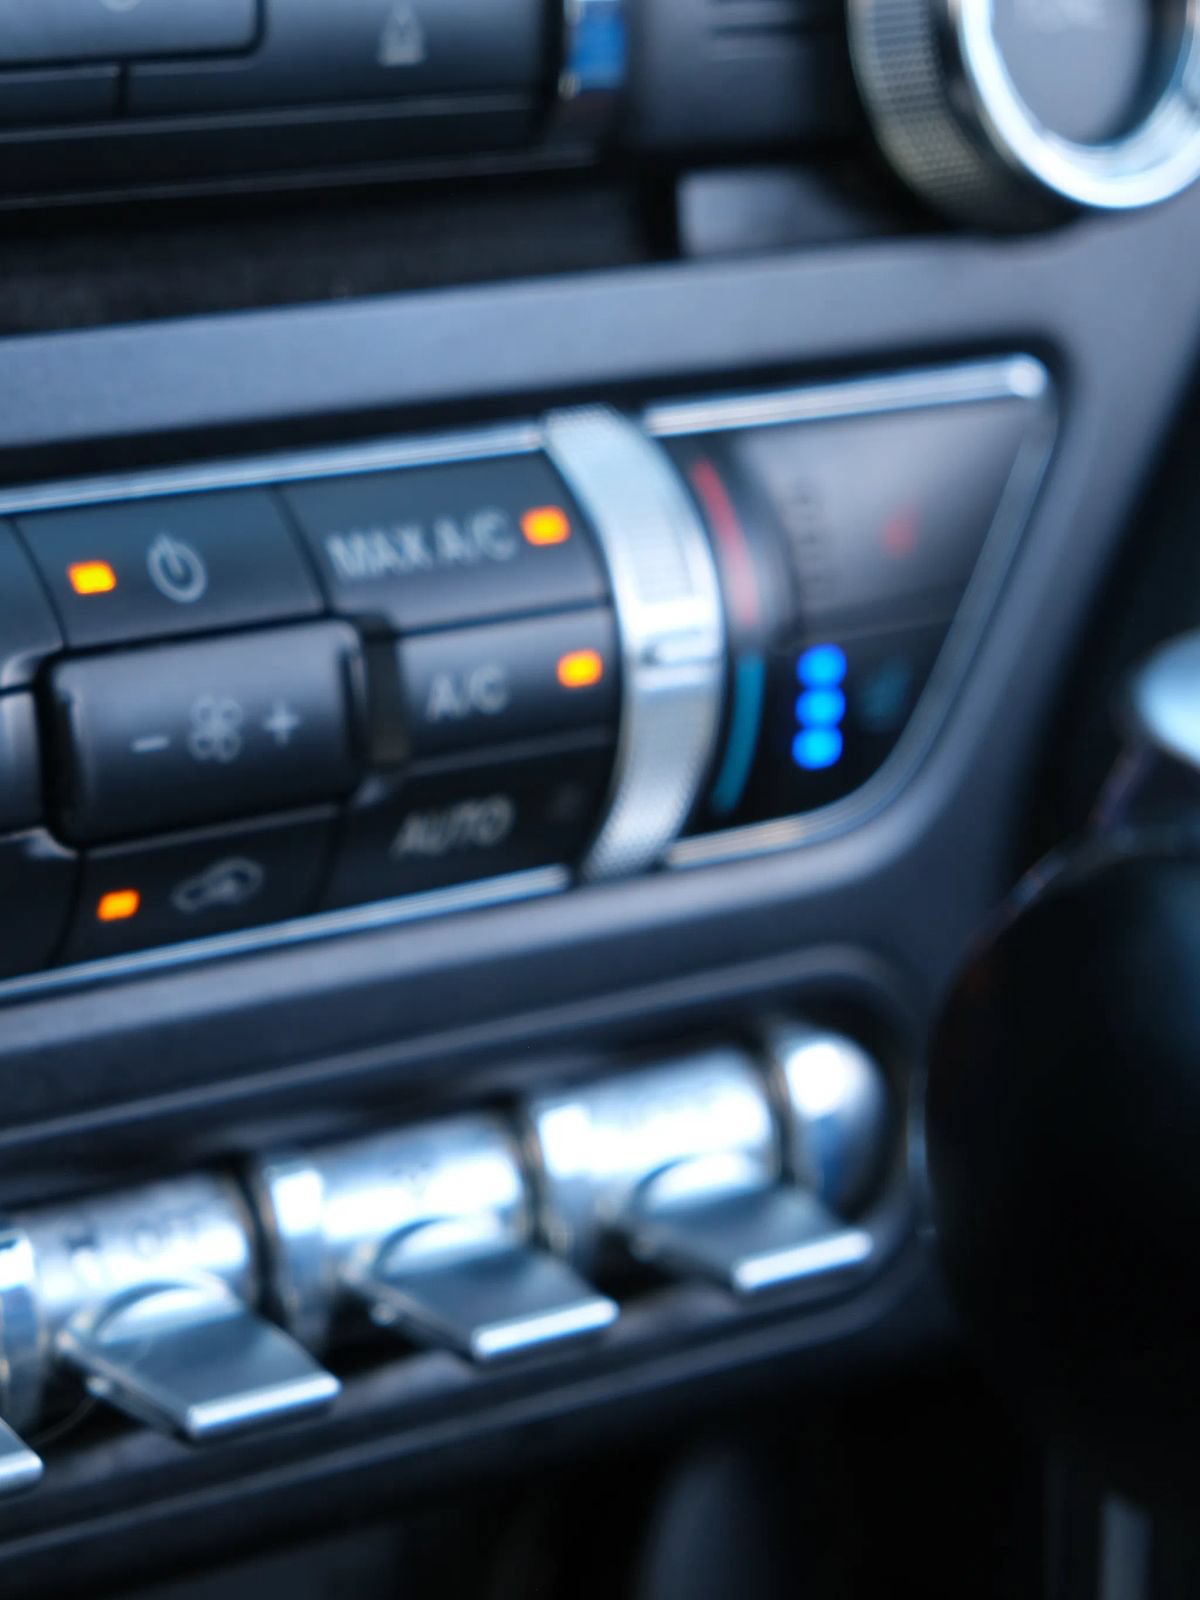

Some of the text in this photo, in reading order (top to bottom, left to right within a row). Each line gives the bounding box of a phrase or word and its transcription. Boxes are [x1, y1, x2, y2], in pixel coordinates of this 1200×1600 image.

[326, 506, 515, 580] MAX A/C
[392, 796, 514, 858] AUTO
